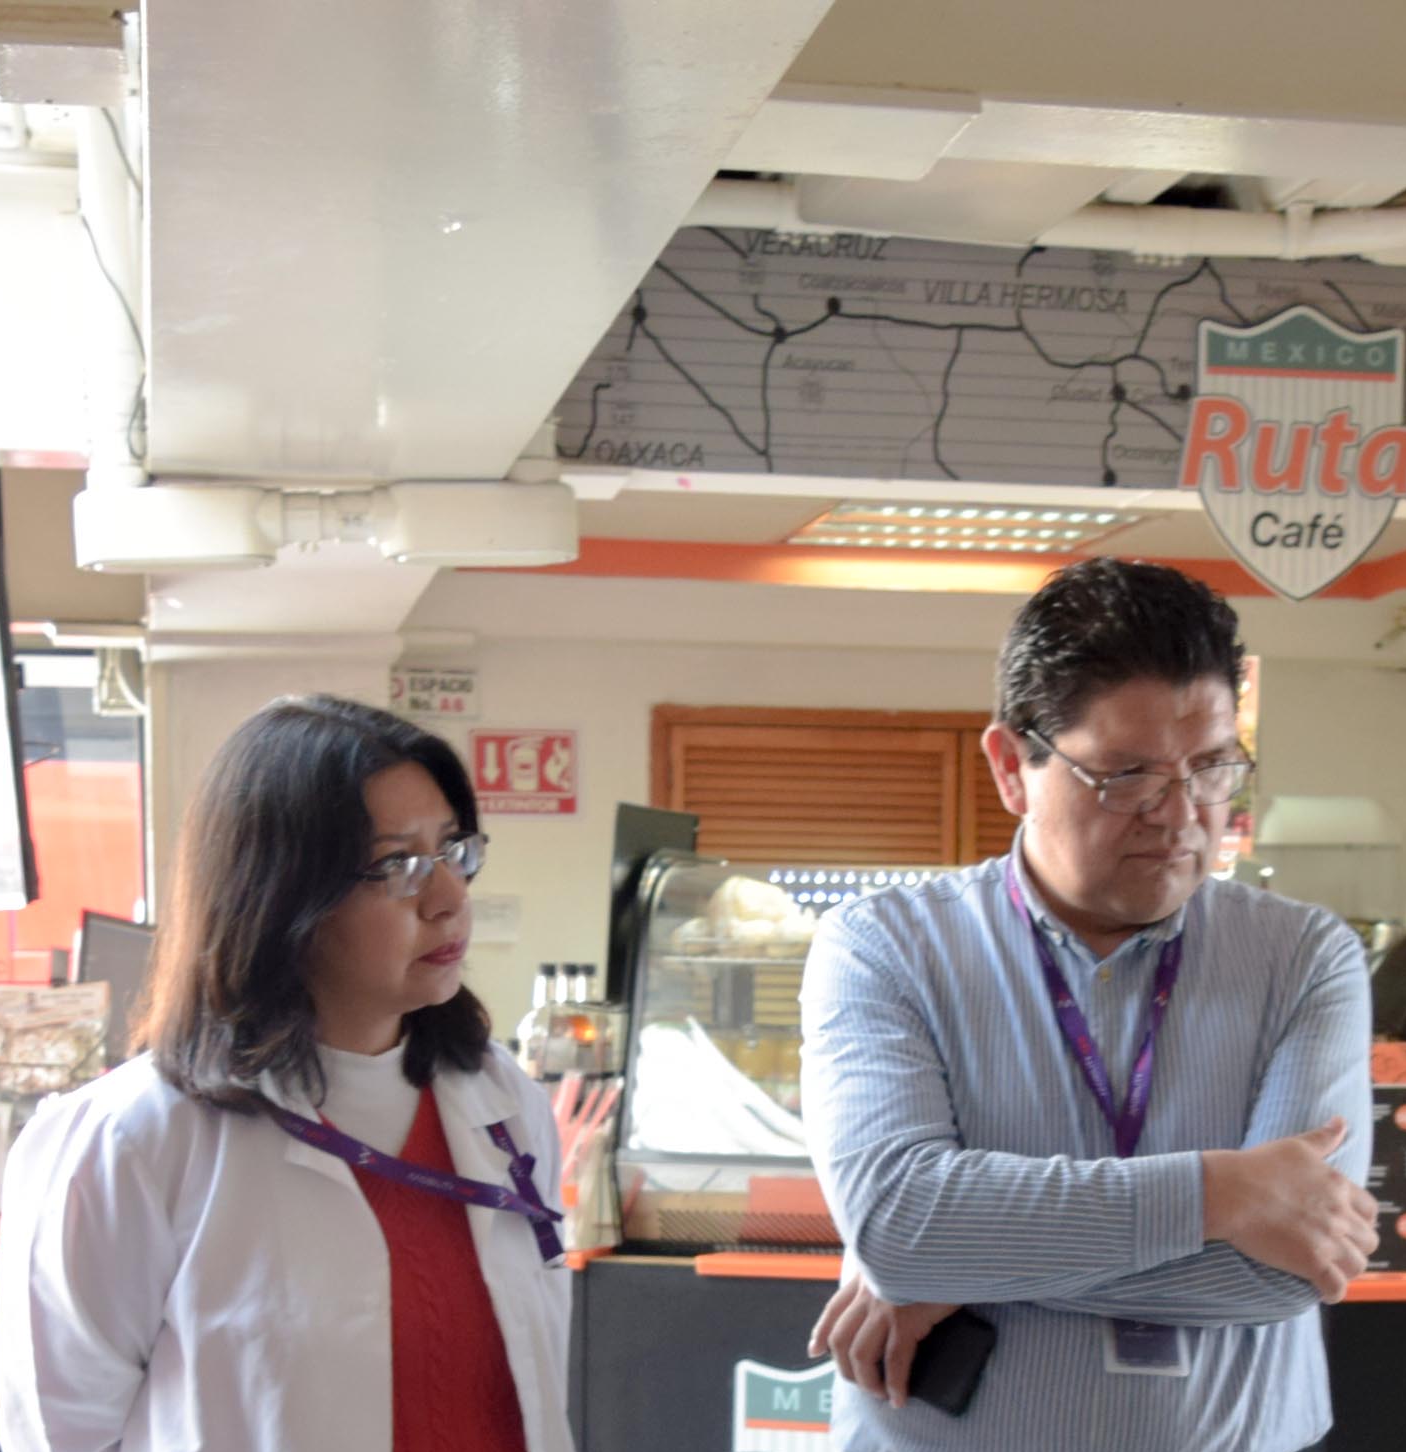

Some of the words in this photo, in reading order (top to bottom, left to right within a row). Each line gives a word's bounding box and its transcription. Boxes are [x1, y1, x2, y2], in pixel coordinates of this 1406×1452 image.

[744, 231, 888, 261] VERACRUZ
[923, 278, 995, 305] VILLA
[1000, 284, 1129, 314] HERMOSA
[1225, 341, 1386, 366] MEXICO
[596, 439, 704, 467] OAXACA
[1250, 511, 1344, 549] Café
[409, 677, 473, 693] ESPACIO
